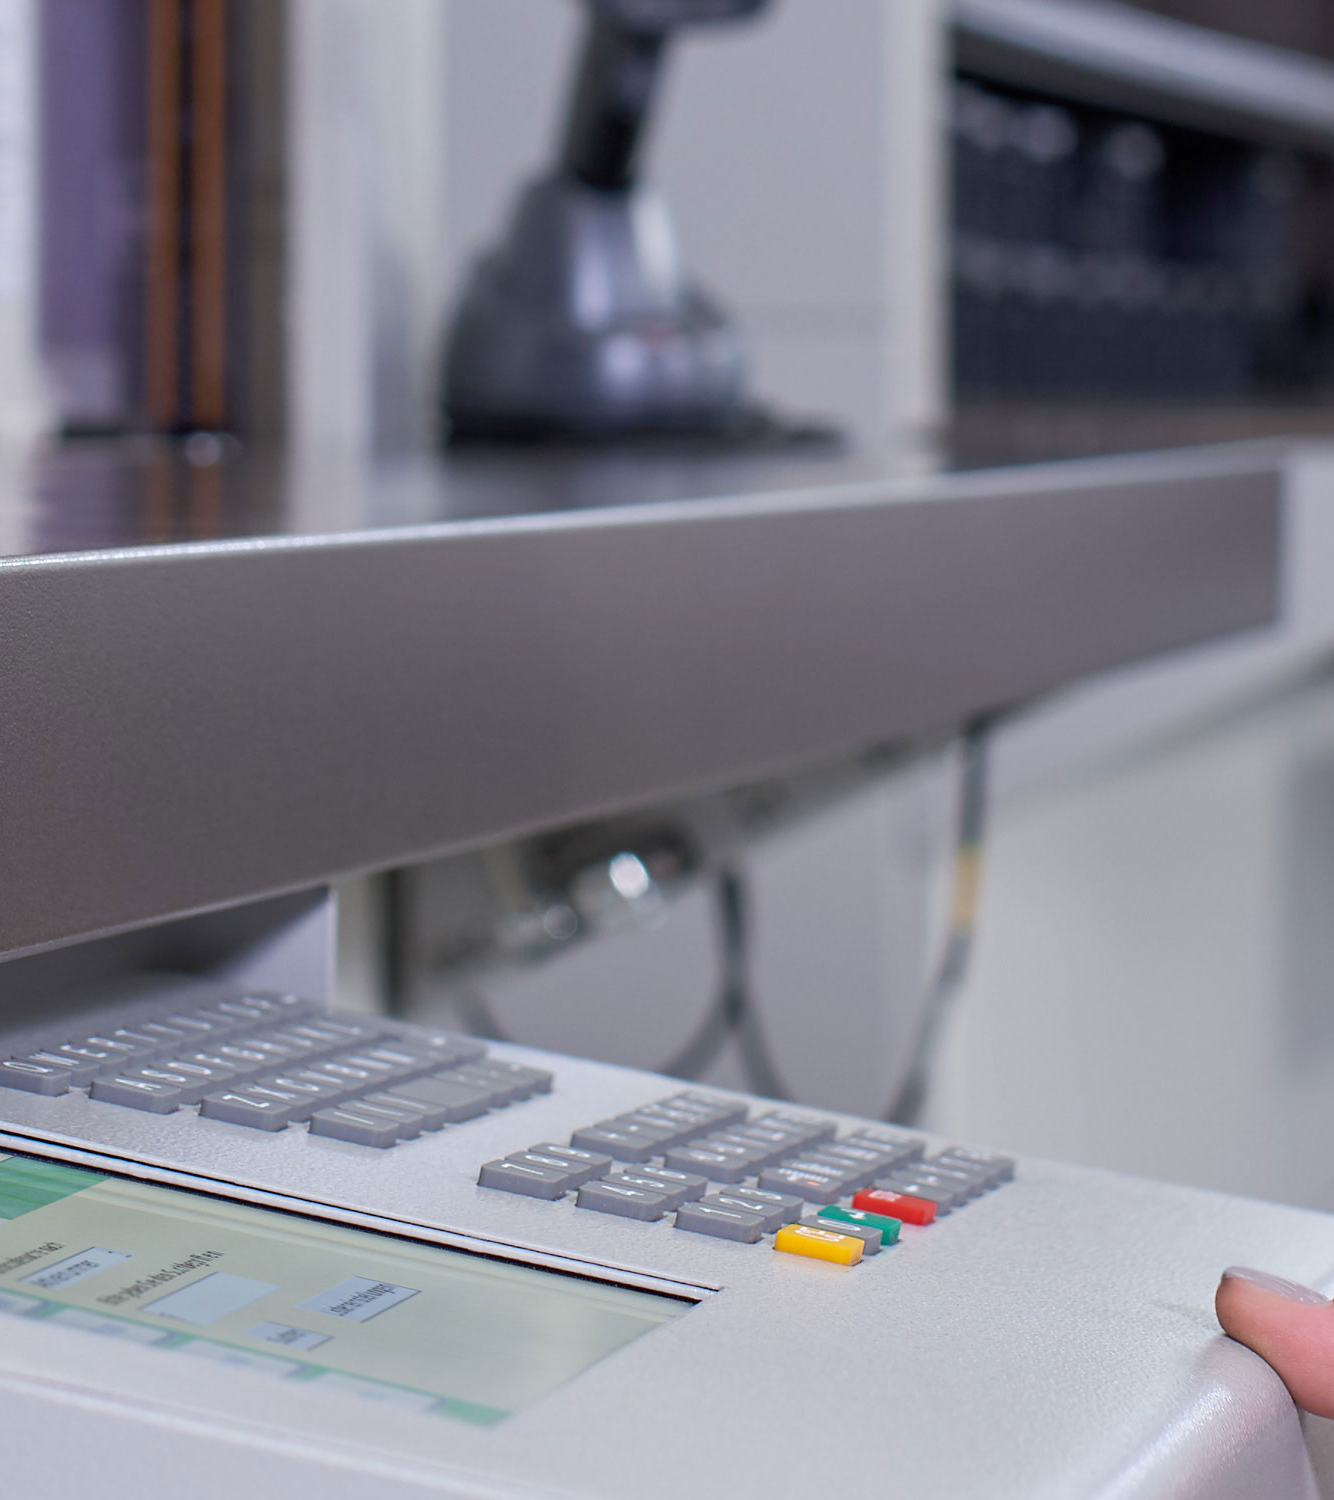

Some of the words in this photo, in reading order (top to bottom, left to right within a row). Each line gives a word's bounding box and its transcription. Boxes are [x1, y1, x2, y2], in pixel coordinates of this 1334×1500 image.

[500, 1162, 544, 1175] 7
[601, 1184, 645, 1197] 4
[718, 1196, 764, 1211] 2
[698, 1206, 742, 1219] 1
